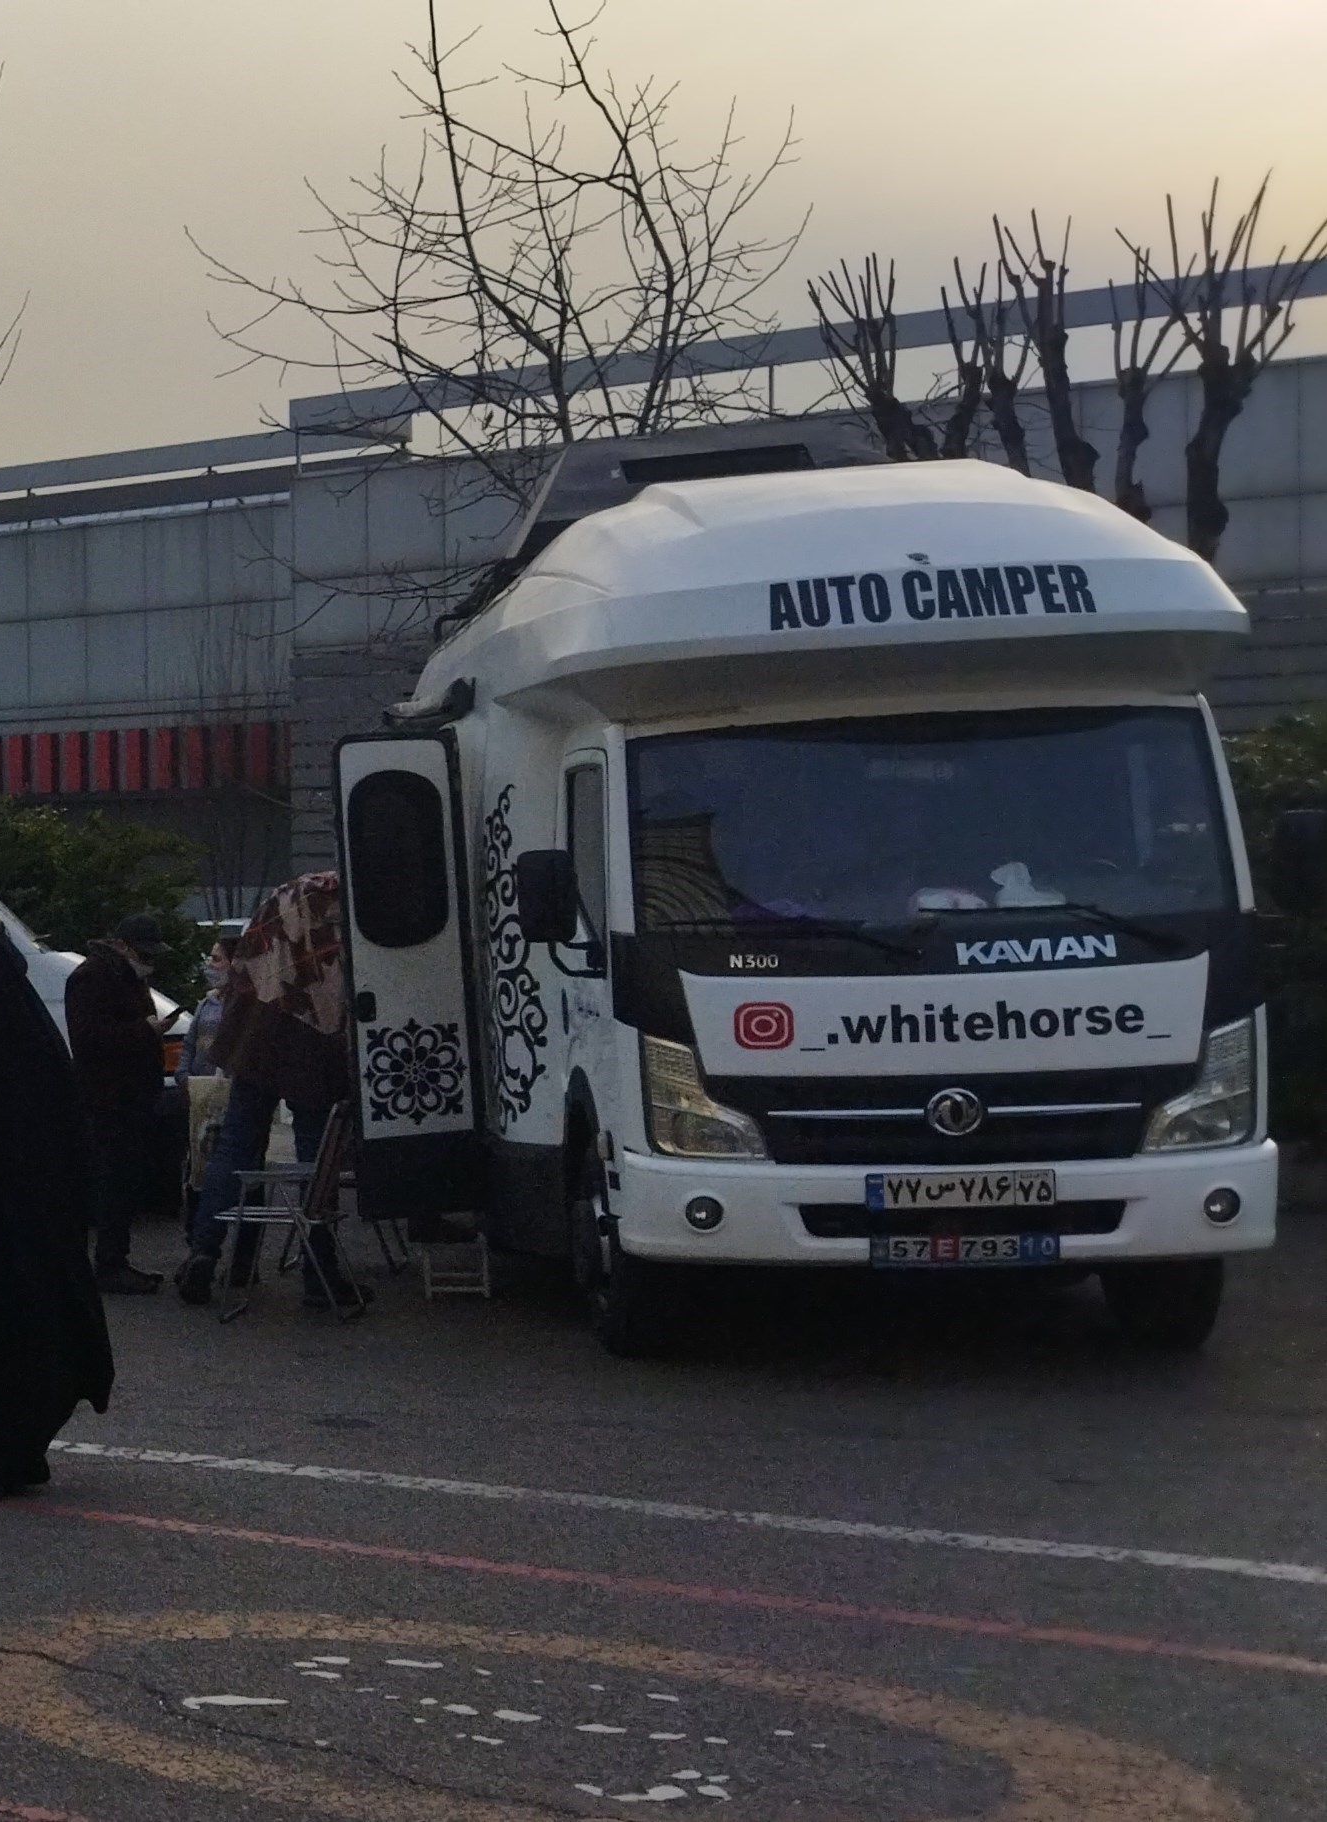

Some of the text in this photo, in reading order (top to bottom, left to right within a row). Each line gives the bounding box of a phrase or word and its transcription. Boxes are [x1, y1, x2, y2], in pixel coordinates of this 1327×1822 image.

[769, 563, 1098, 631] AUTO CAMPER
[729, 953, 779, 969] N300
[955, 934, 1118, 966] KAVIAN
